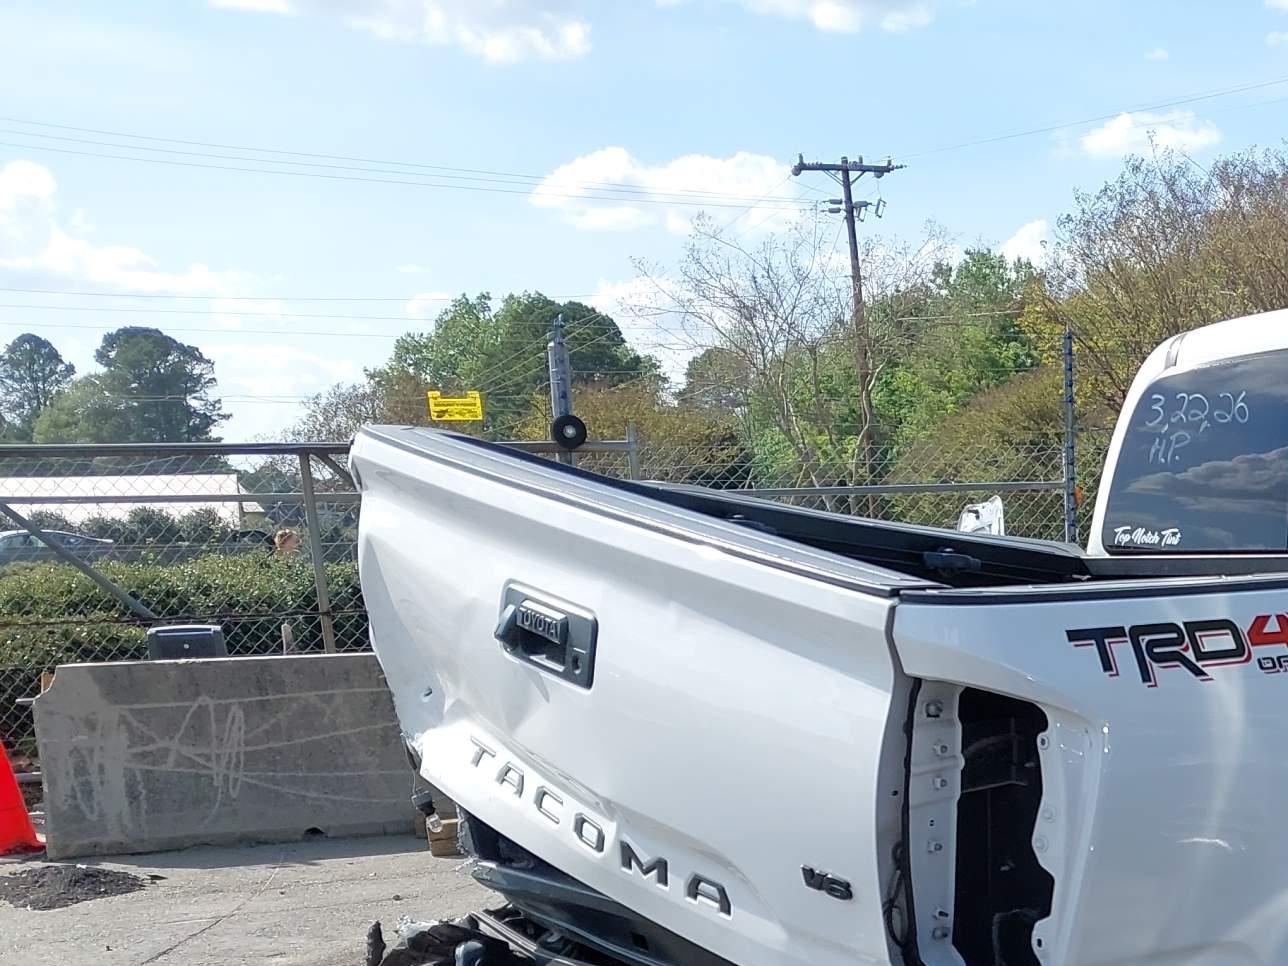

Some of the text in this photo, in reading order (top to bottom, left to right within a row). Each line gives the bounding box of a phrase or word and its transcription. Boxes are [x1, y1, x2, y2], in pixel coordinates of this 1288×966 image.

[1114, 526, 1181, 547] Top Notch Tint
[518, 606, 560, 641] TOYOTA
[470, 735, 733, 920] TACOMA
[801, 864, 854, 901] V6
